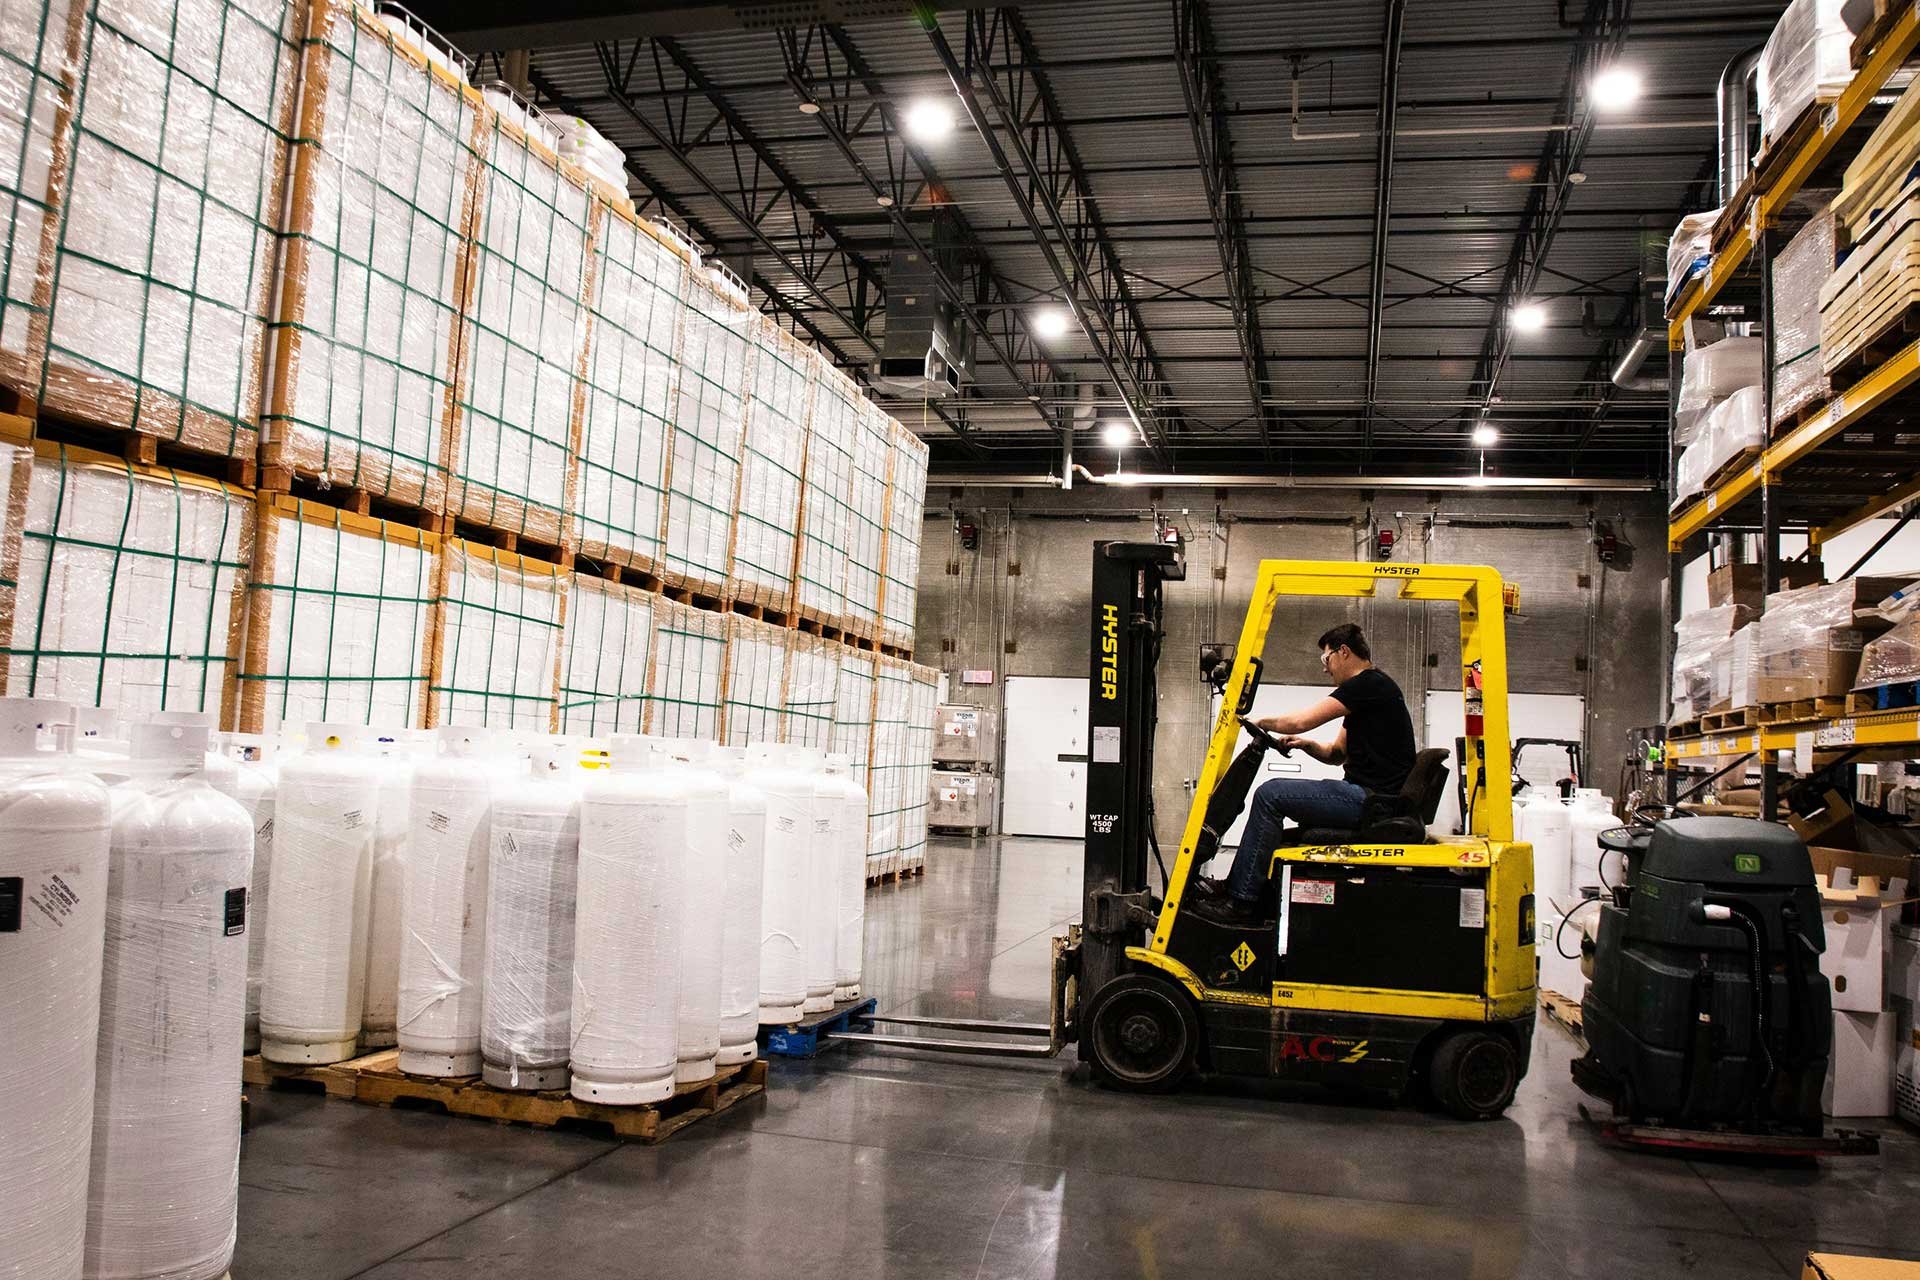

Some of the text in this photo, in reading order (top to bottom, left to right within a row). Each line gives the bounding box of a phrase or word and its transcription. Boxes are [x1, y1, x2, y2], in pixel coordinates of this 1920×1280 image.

[1374, 566, 1420, 576] HYSTER
[1102, 604, 1118, 700] HYSTER
[1092, 820, 1112, 828] 4500
[1093, 826, 1111, 834] LBS
[1457, 852, 1485, 863] 45
[1238, 949, 1249, 966] EE
[1280, 1034, 1335, 1062] AC
